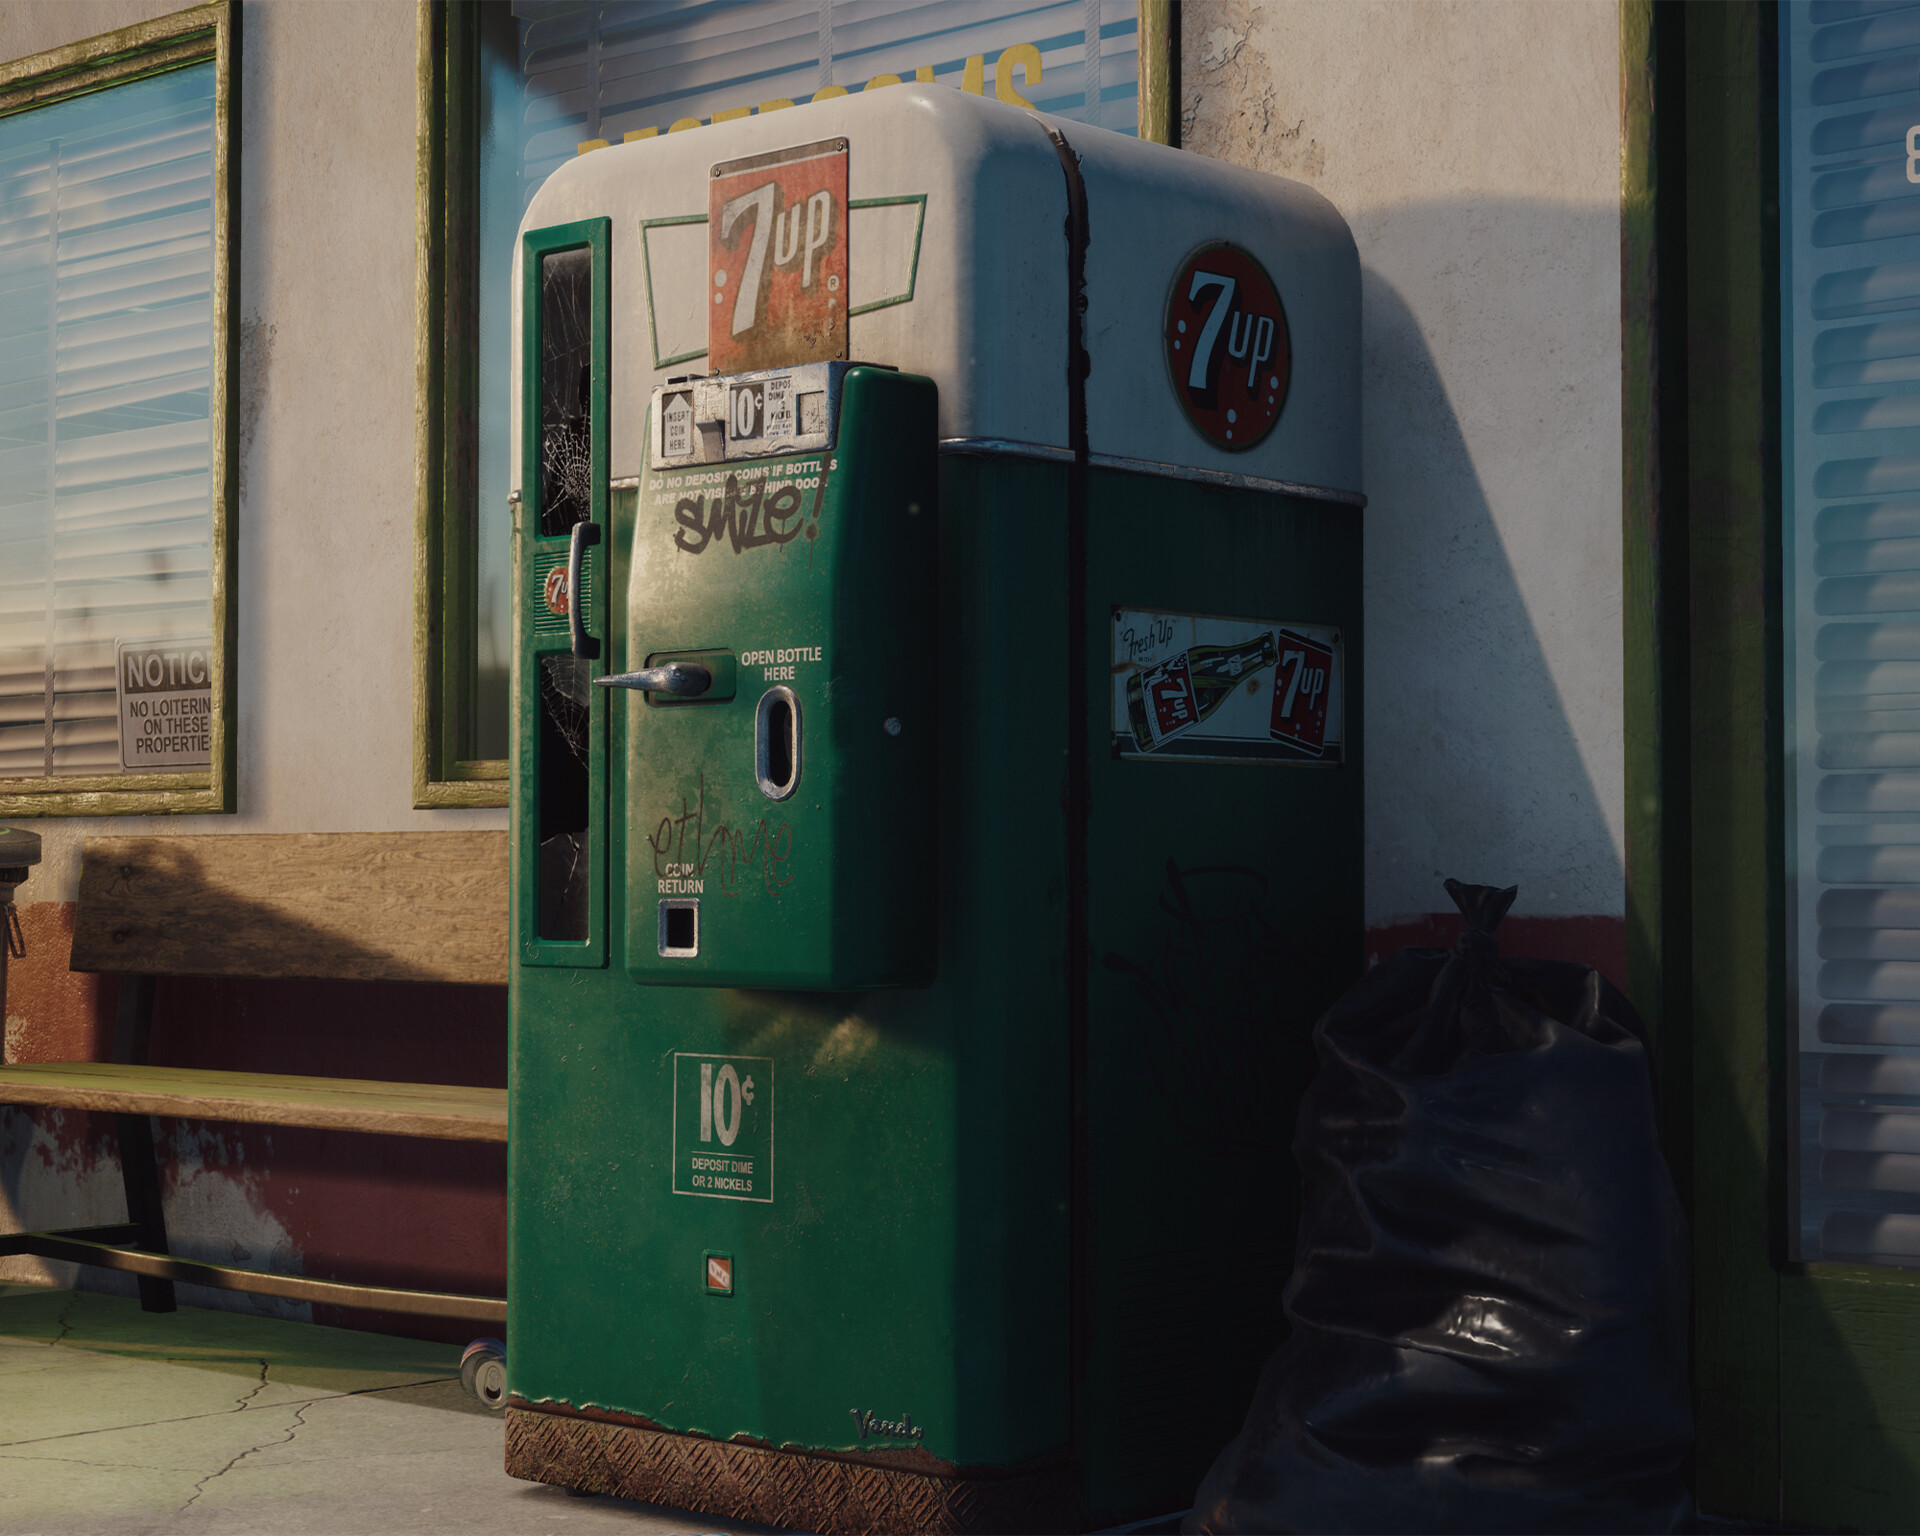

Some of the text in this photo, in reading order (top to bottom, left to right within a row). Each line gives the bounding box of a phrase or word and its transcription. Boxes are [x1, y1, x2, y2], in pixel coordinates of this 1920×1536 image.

[648, 458, 838, 491] DO NO DEPOSIT COINS IF BOTTLS
[654, 492, 677, 506] ARE
[749, 479, 793, 495] BHIND
[795, 476, 828, 490] DOO
[741, 646, 822, 667] OPEN BOTTLE
[764, 665, 795, 681] HERE
[130, 697, 211, 718] NO LOITERIN
[143, 716, 209, 735] ON THESE
[136, 735, 212, 754] PROPERTIE
[665, 862, 695, 877] COIN
[657, 879, 704, 894] RETURN
[691, 1157, 754, 1175] DEPOSIT DIME
[692, 1174, 753, 1192] OR 2 NICKELS
